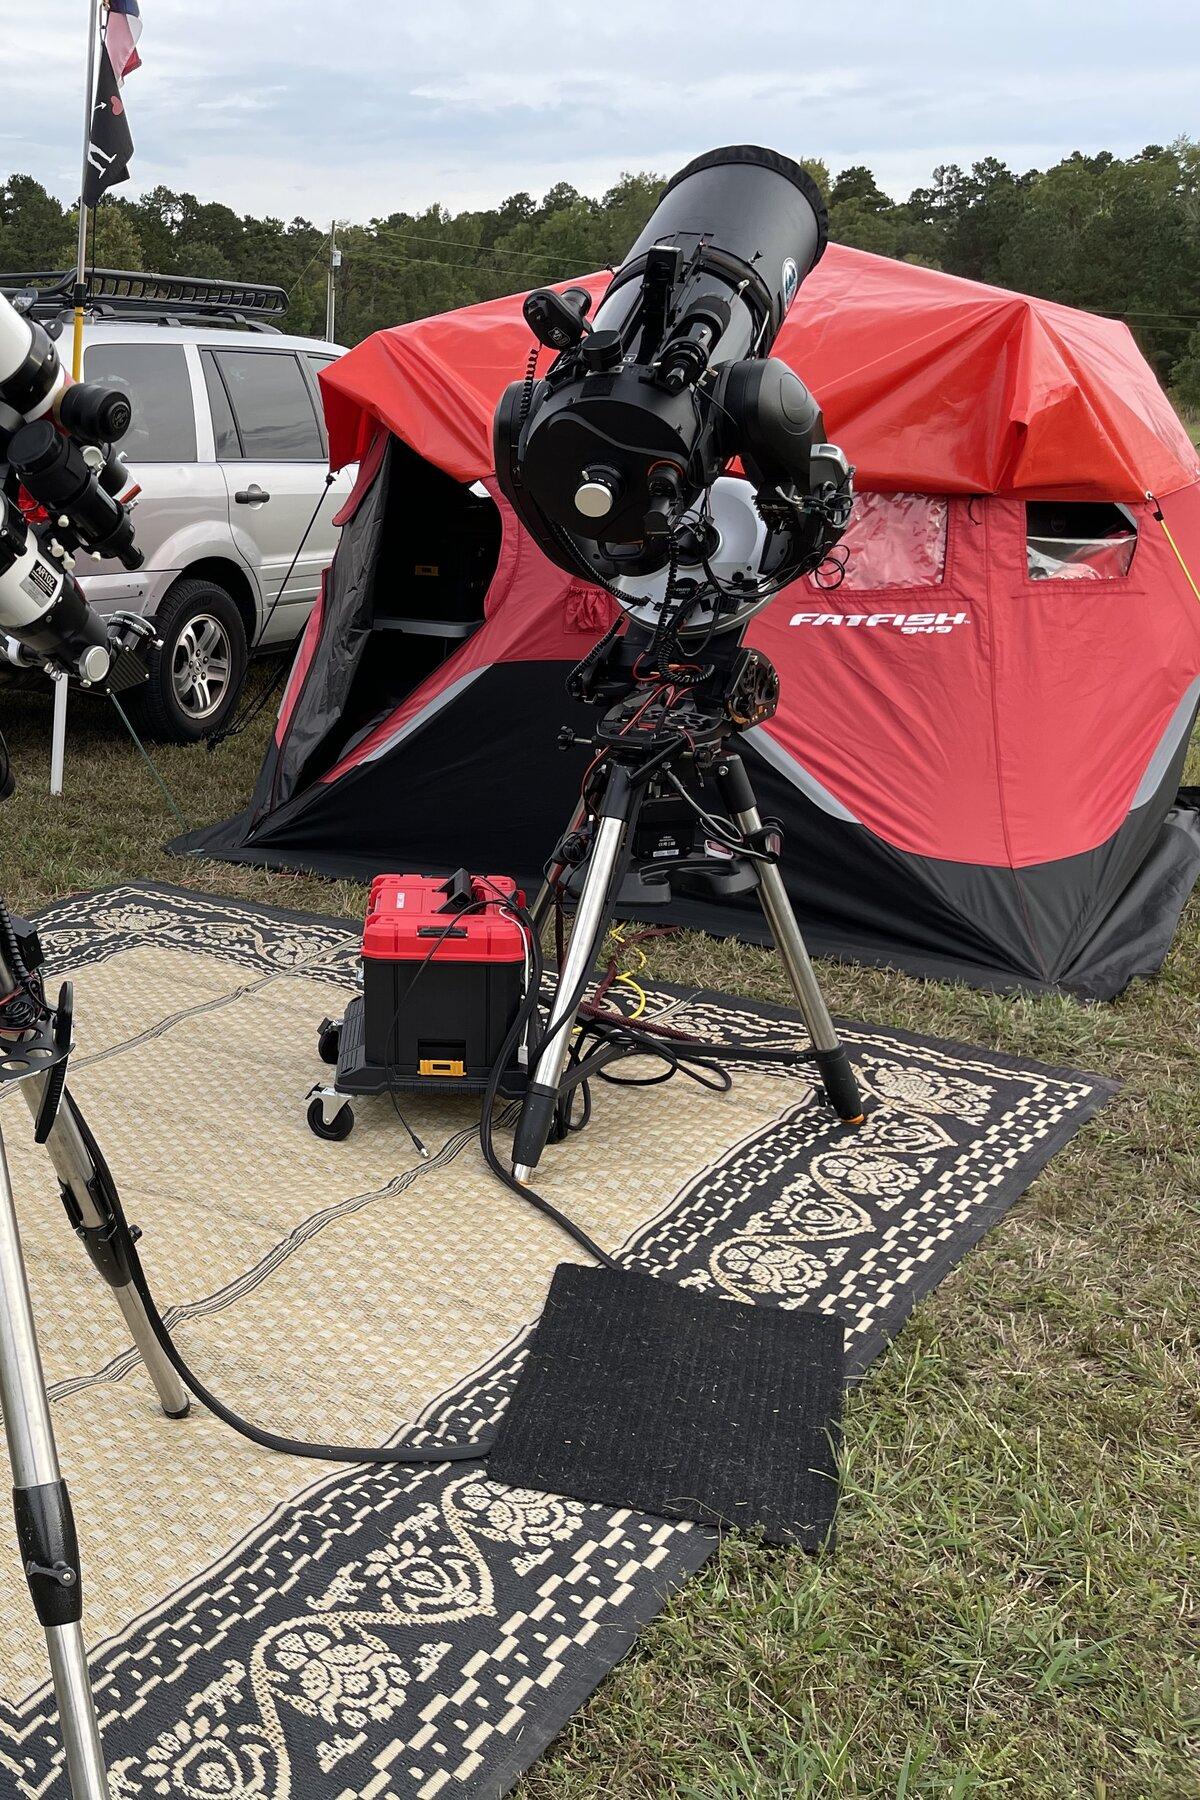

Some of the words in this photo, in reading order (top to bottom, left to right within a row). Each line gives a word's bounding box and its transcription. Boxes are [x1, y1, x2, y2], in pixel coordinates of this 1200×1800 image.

[35, 565, 55, 588] AR102
[789, 612, 967, 627] FATFISH
[900, 625, 953, 635] 949
